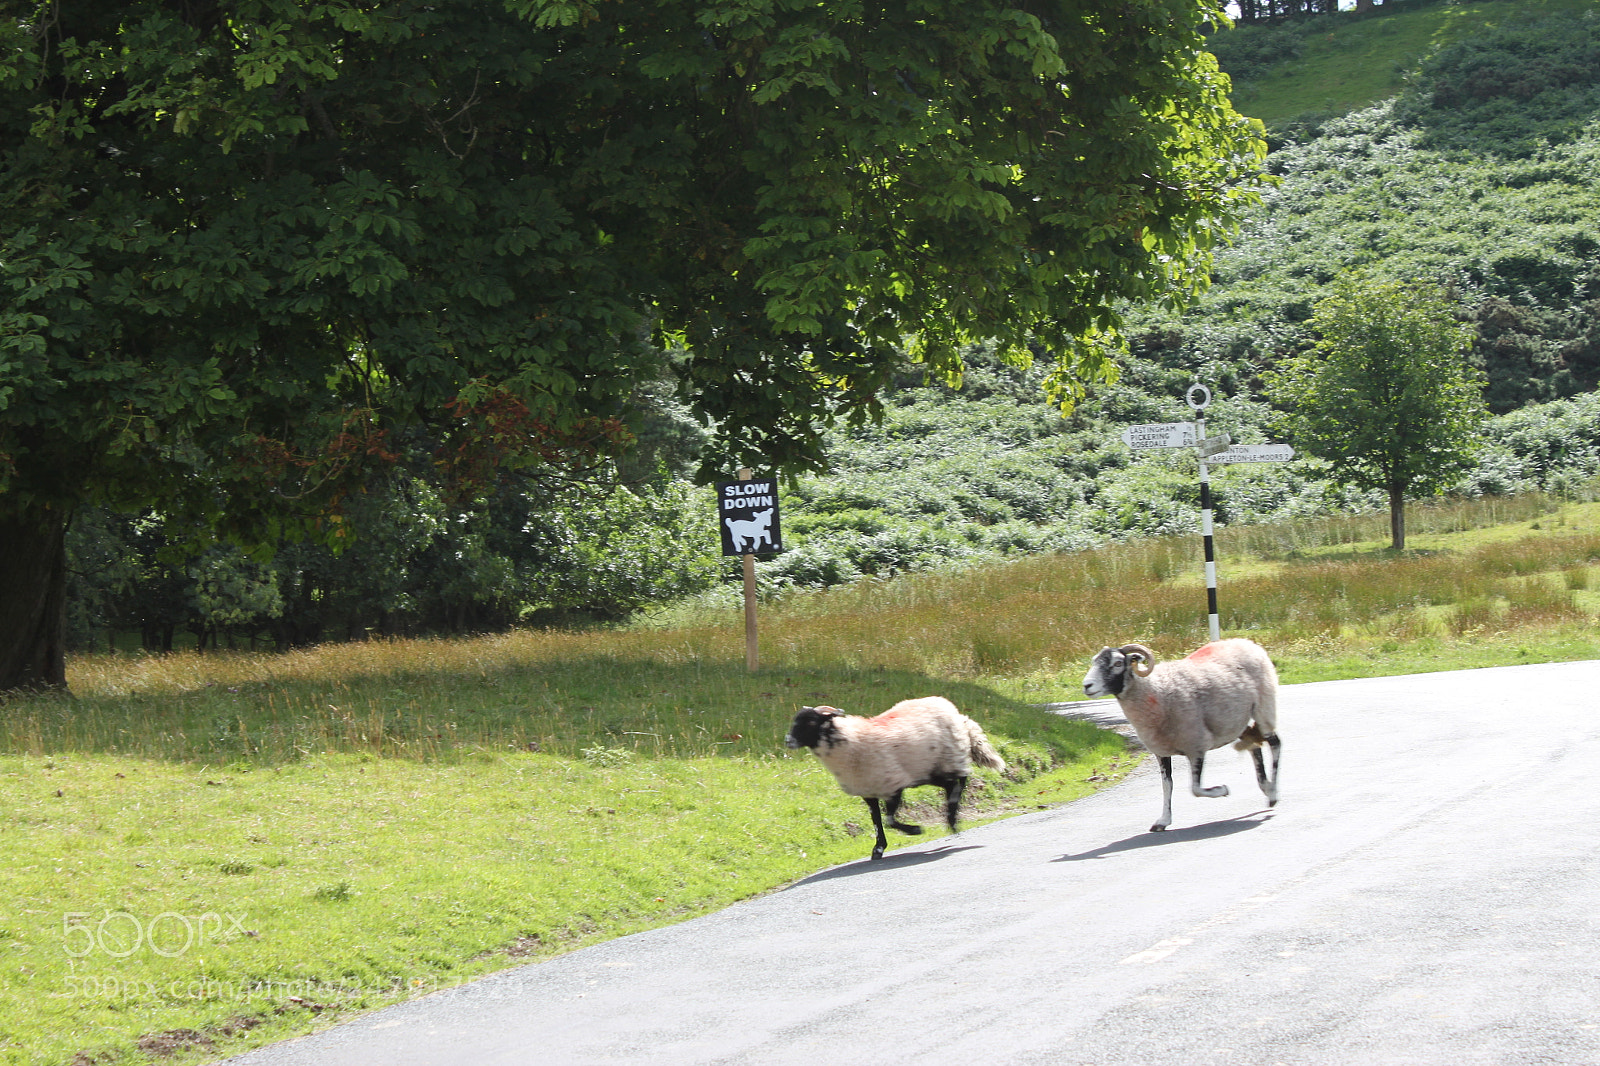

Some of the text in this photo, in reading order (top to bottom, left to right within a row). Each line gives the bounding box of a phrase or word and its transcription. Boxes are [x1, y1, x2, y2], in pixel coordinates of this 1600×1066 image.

[1129, 425, 1177, 434] LASTINGHAM
[1130, 432, 1170, 441] PICKERING
[1130, 440, 1168, 448] ROSEDALE
[1213, 453, 1283, 462] APPLETON-LE-MOORS
[724, 483, 770, 497] SLOW
[723, 495, 773, 510] DOWN
